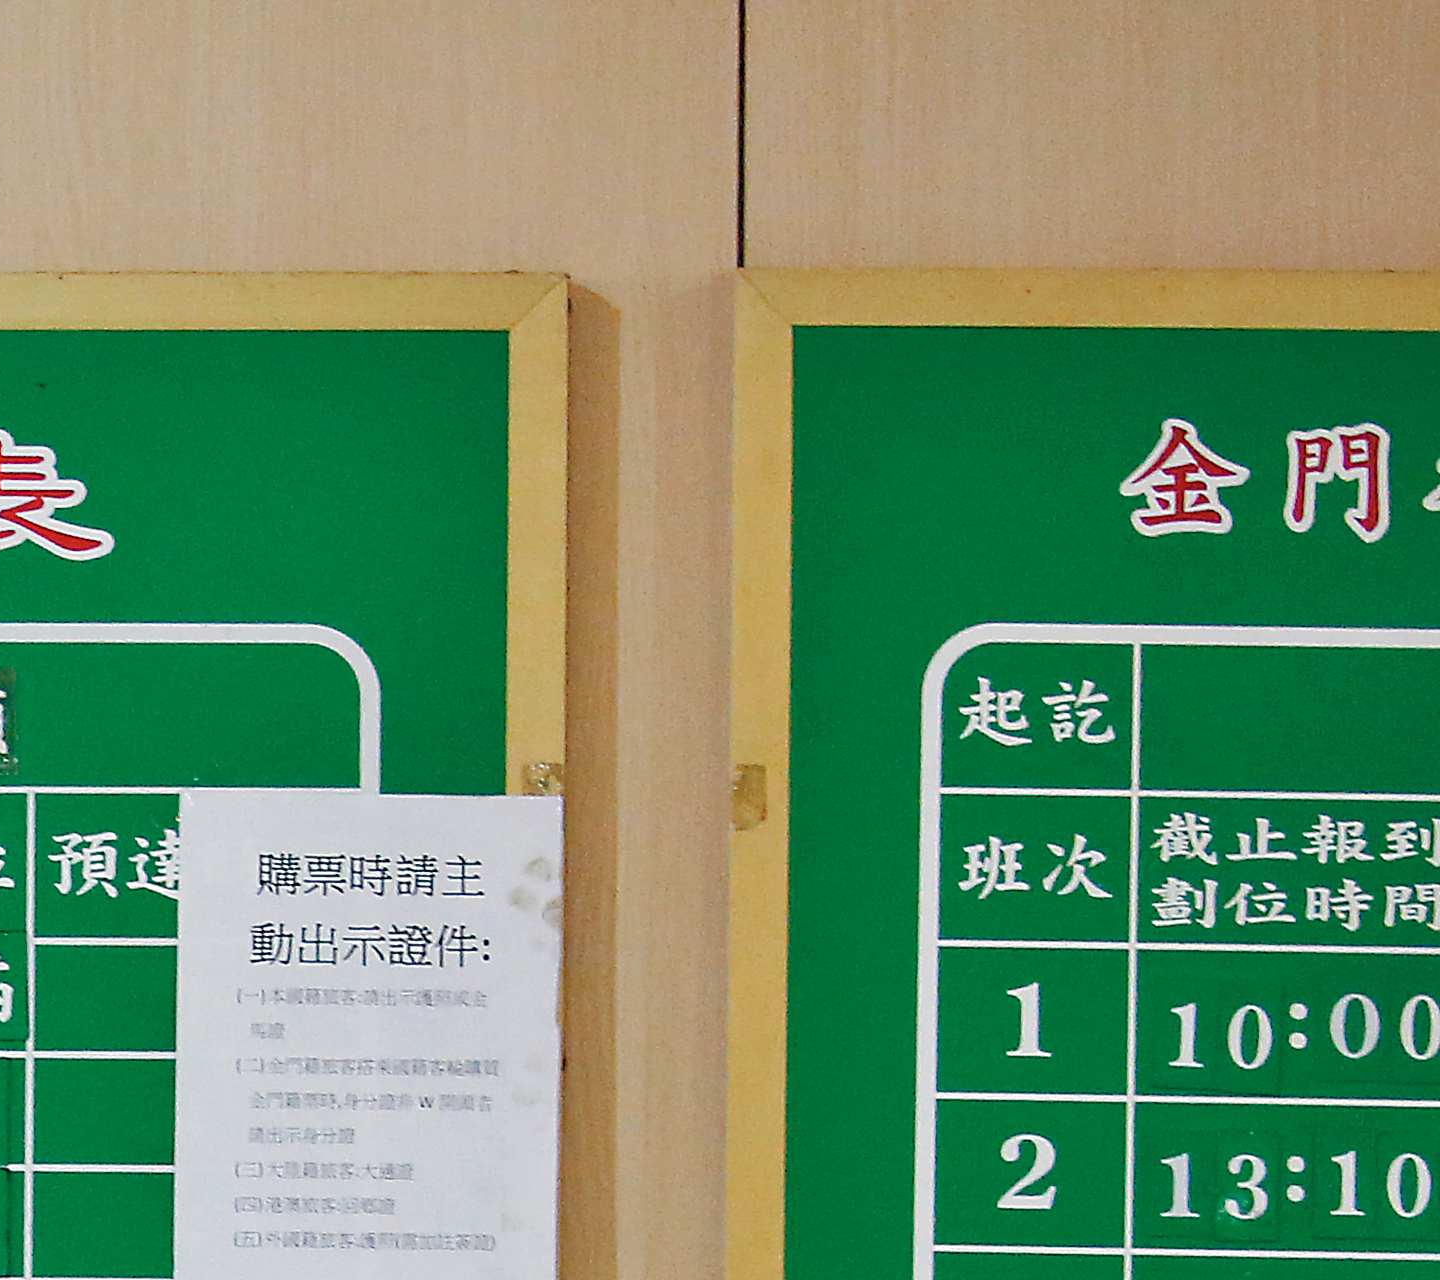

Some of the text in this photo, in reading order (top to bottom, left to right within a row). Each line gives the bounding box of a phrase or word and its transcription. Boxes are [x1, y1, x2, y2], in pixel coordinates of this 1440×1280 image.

[1120, 419, 1440, 543] 金門
[959, 677, 1115, 745] 起訖
[959, 834, 1112, 899] 班次
[1151, 812, 1440, 866] 截止報到
[257, 855, 485, 897] 購票時請主
[1152, 877, 1440, 931] 劃位時間
[249, 923, 492, 968] 動出示證件:
[1006, 982, 1440, 1069] 1 10:00
[997, 1135, 1431, 1219] 2 13:10
